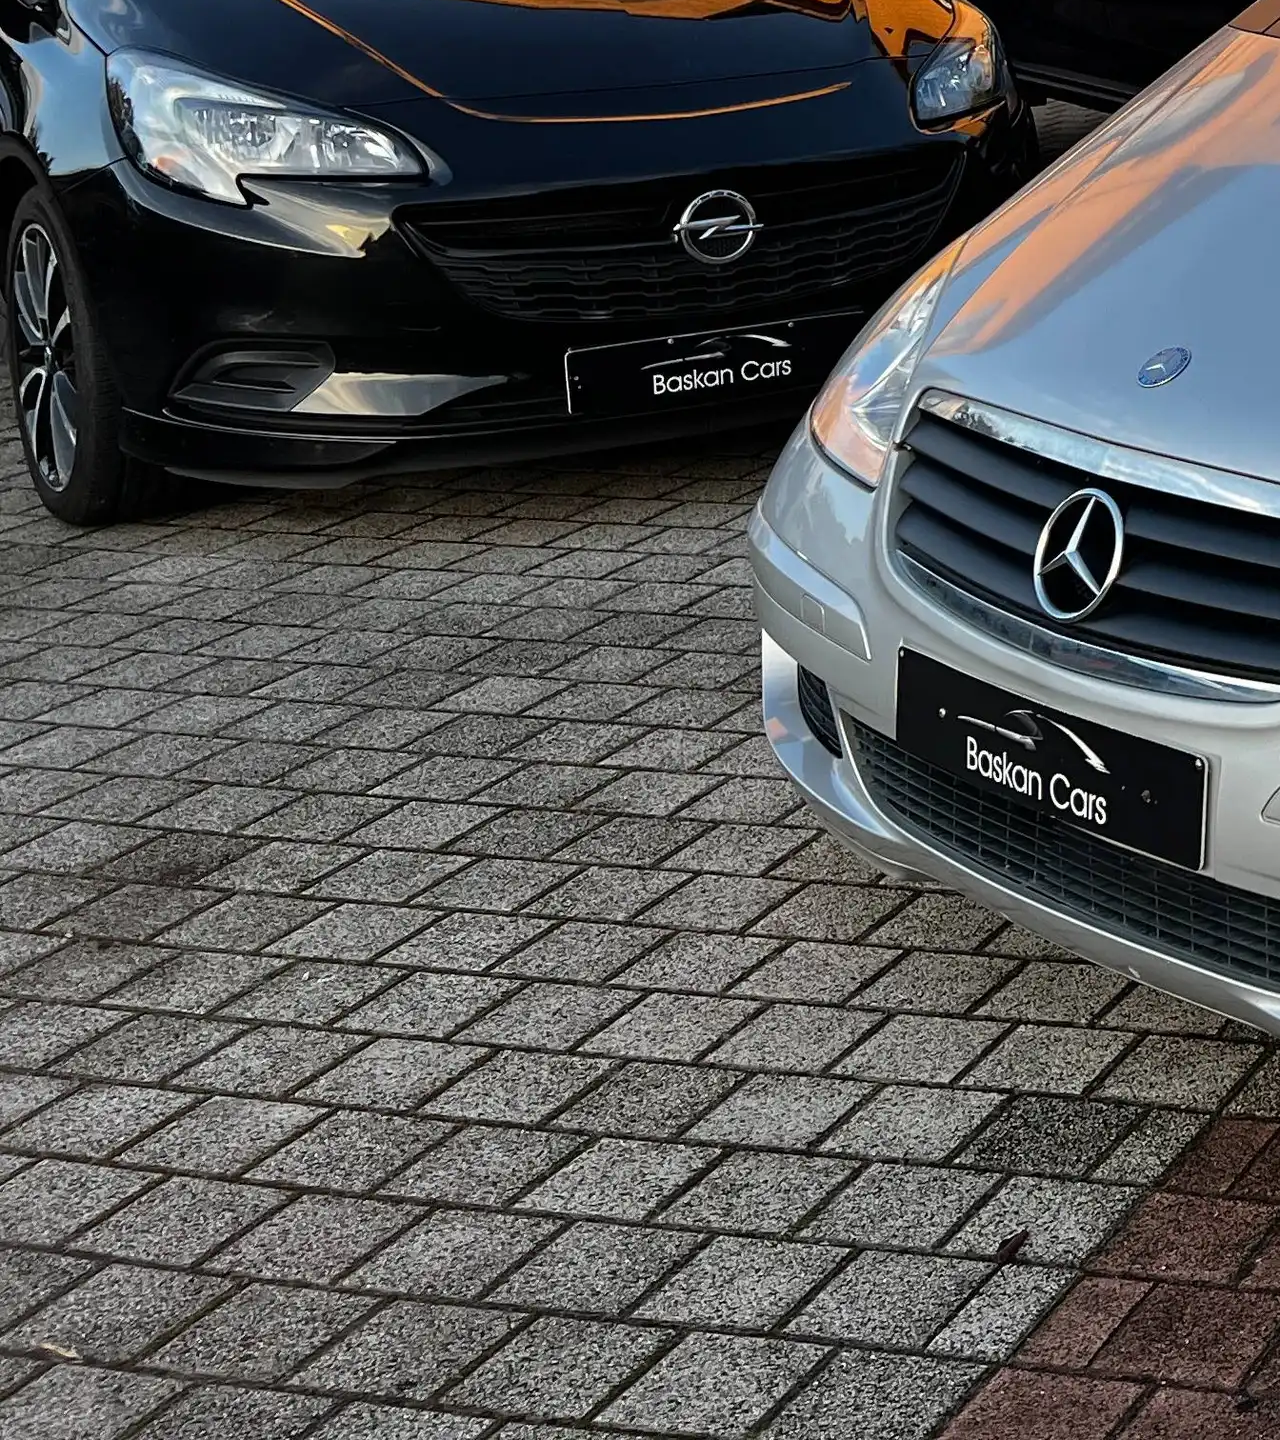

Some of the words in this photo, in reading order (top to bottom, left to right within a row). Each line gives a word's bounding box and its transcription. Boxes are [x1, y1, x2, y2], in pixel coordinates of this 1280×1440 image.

[652, 368, 734, 395] Baskan
[740, 359, 792, 381] Cars
[966, 735, 1042, 801] Baskan
[1049, 772, 1108, 826] Cars
